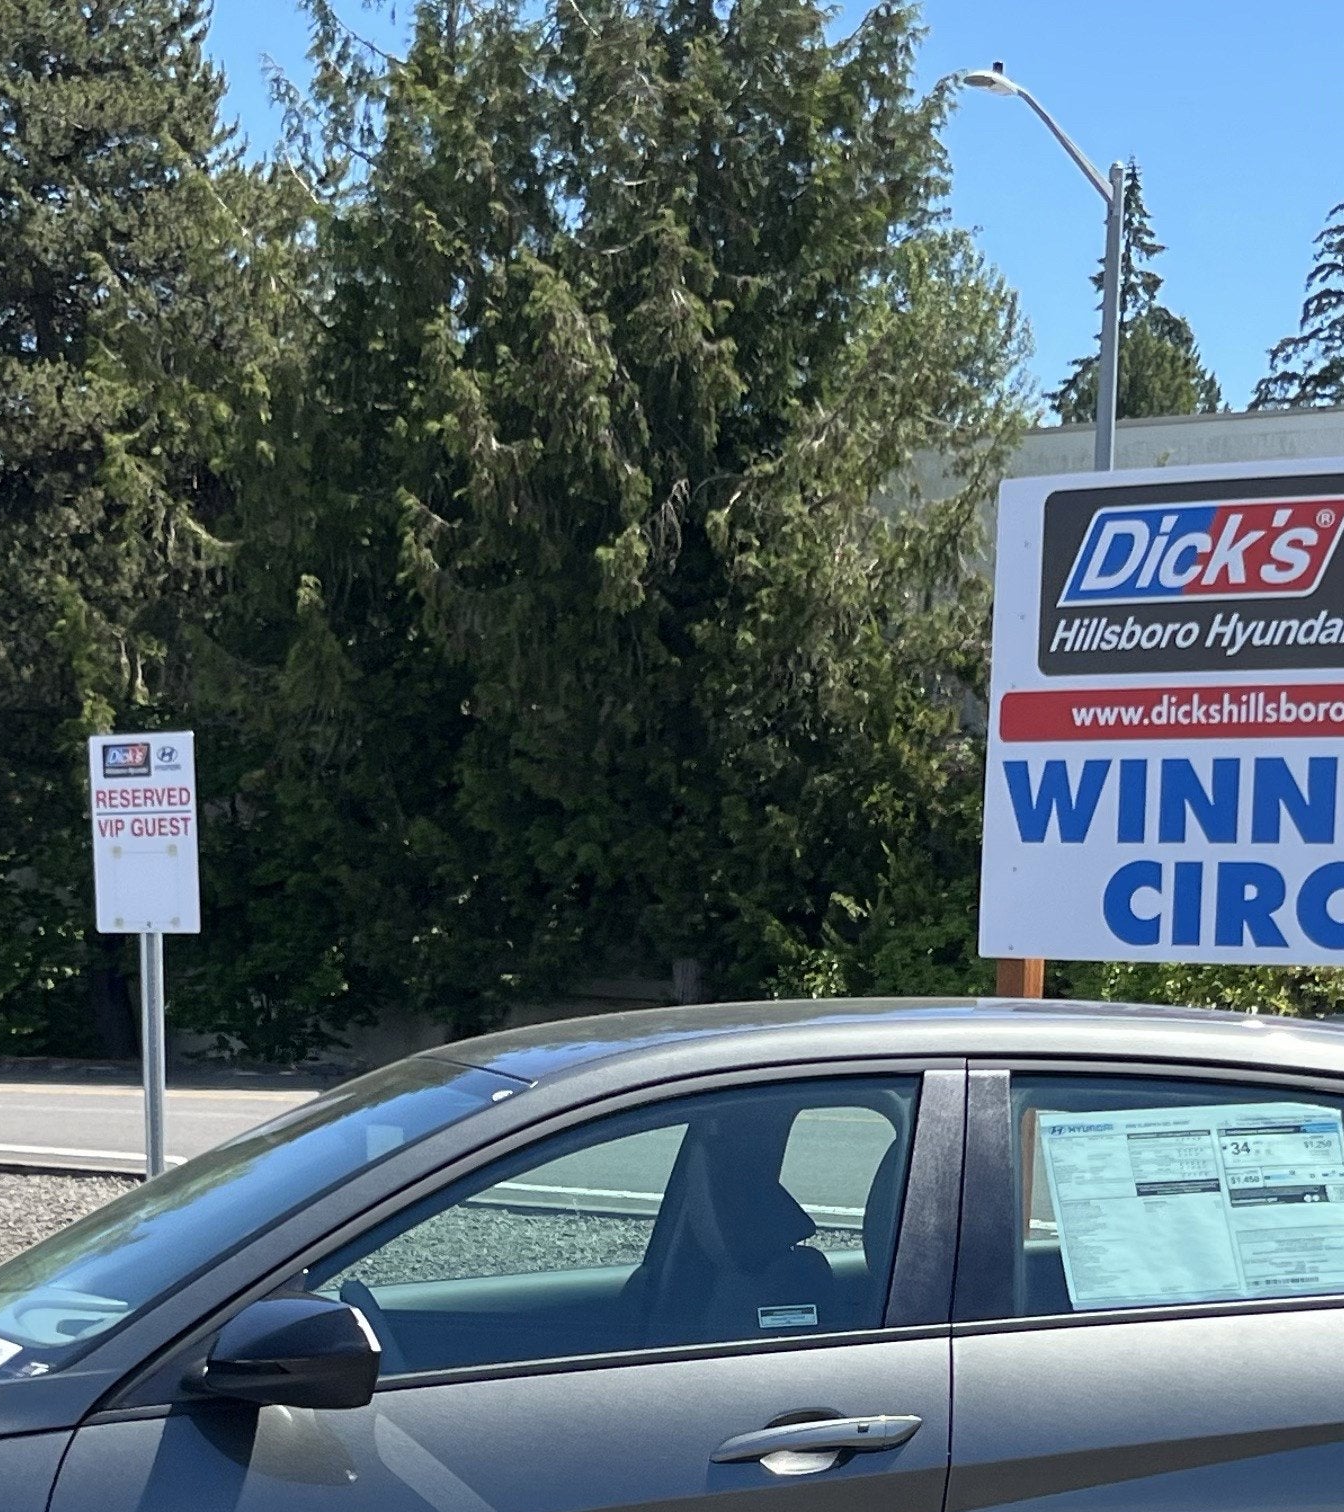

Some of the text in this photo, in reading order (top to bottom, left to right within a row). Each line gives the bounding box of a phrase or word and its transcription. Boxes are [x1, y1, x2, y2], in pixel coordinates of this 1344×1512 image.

[1080, 508, 1318, 591] Dick's
[1050, 617, 1200, 652] Hillsboro
[95, 787, 191, 808] RESERVED
[98, 817, 192, 837] VIP GUEST
[1230, 1141, 1251, 1156] 34
